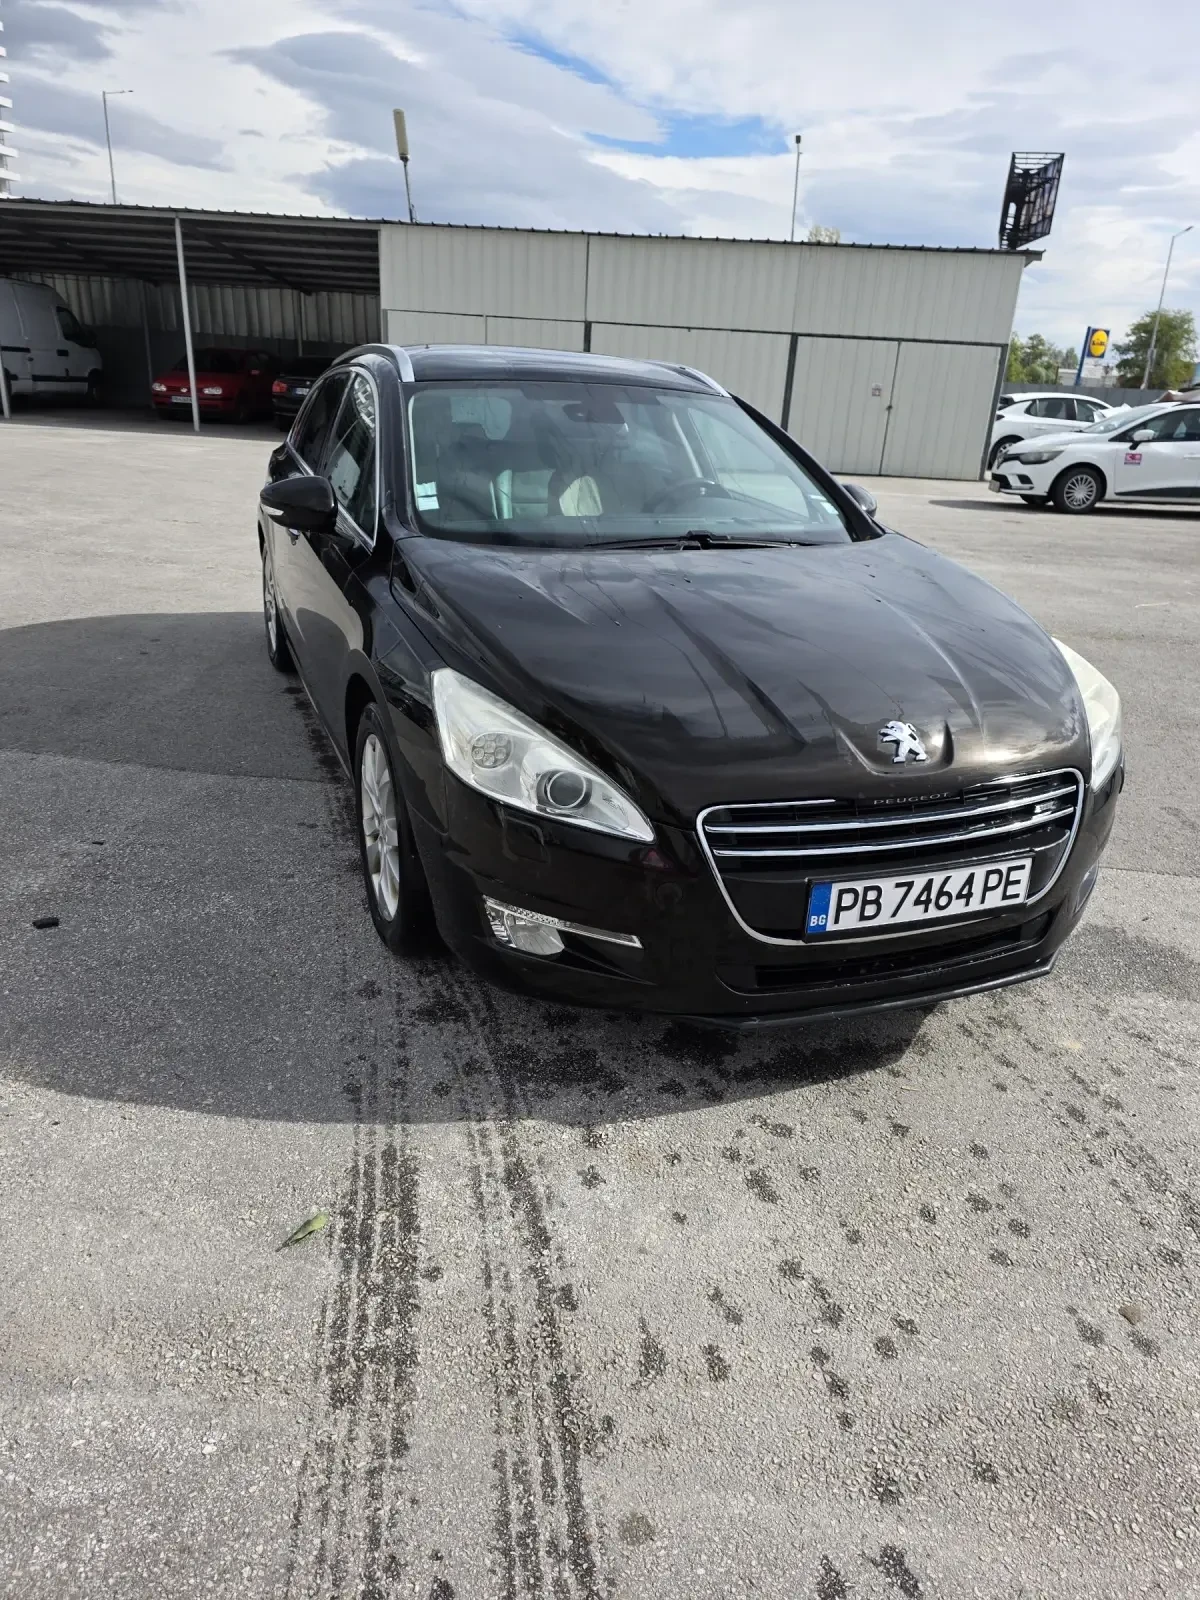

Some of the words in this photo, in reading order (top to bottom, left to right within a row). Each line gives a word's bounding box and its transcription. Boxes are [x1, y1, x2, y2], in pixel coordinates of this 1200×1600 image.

[873, 791, 951, 805] PEUGEOT
[834, 886, 883, 925] PB
[890, 872, 975, 919] 7464
[981, 864, 1026, 905] PE
[809, 914, 827, 927] BG
